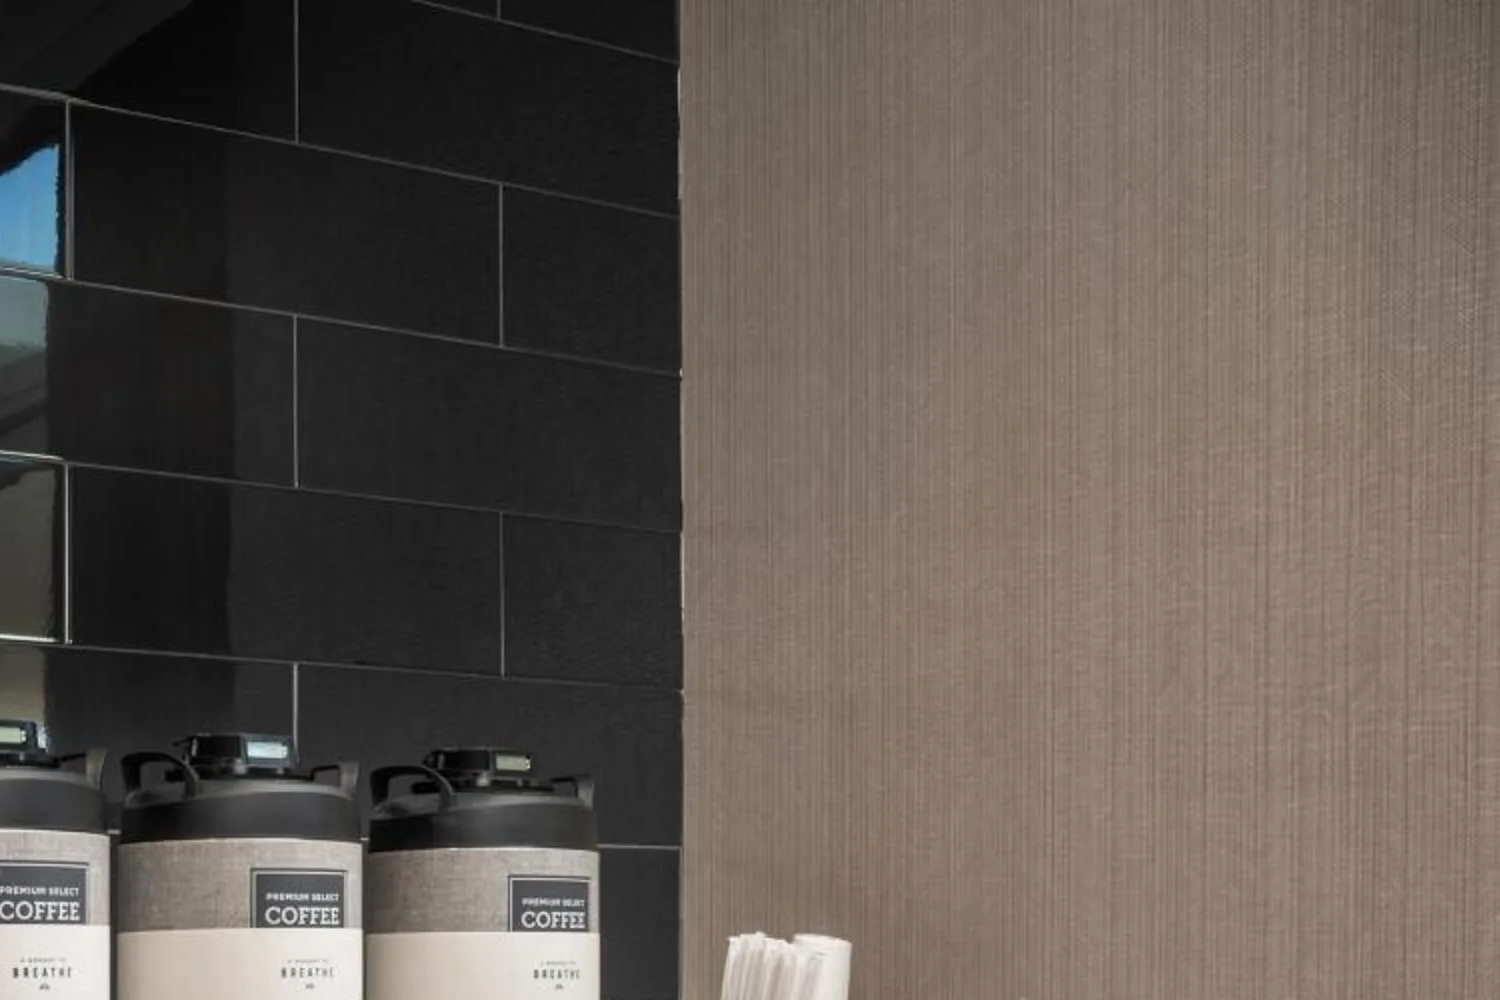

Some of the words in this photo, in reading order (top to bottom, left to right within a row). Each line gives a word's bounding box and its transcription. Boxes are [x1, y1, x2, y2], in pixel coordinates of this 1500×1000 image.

[0, 885, 46, 895] PREMIUM
[49, 887, 79, 897] SELECT
[265, 892, 309, 901] PREMIUM
[311, 893, 340, 902] SELECT
[265, 906, 340, 925] COFFEE
[521, 911, 586, 929] COFFEE
[12, 966, 72, 979] BREATHE
[280, 966, 334, 979] BREATHE
[533, 968, 580, 980] BREATHE
